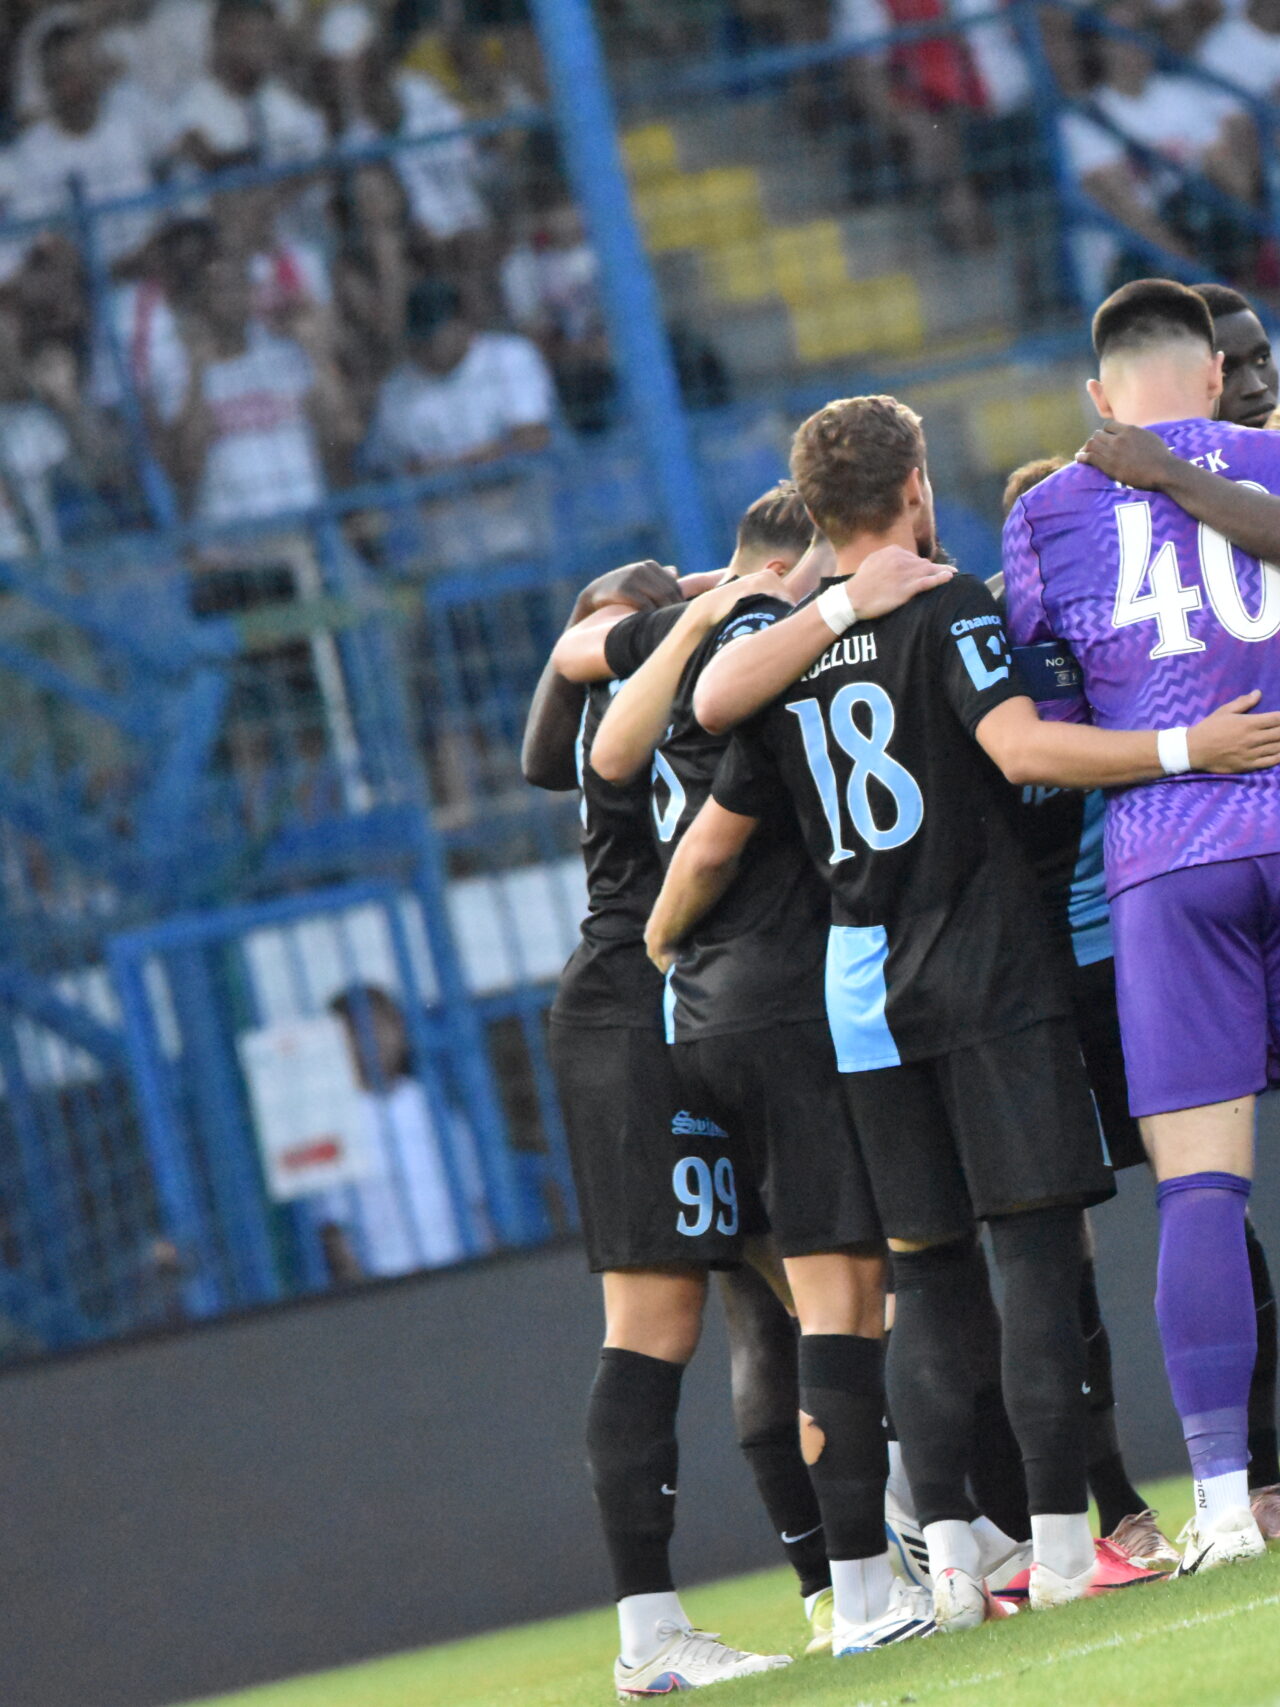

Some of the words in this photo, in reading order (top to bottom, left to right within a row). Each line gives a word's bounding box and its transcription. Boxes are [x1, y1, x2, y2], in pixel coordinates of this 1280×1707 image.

[950, 615, 1002, 636] Chanc
[801, 631, 878, 682] ELUH
[1045, 656, 1065, 667] NO
[786, 682, 924, 864] 18
[672, 1156, 739, 1237] 99
